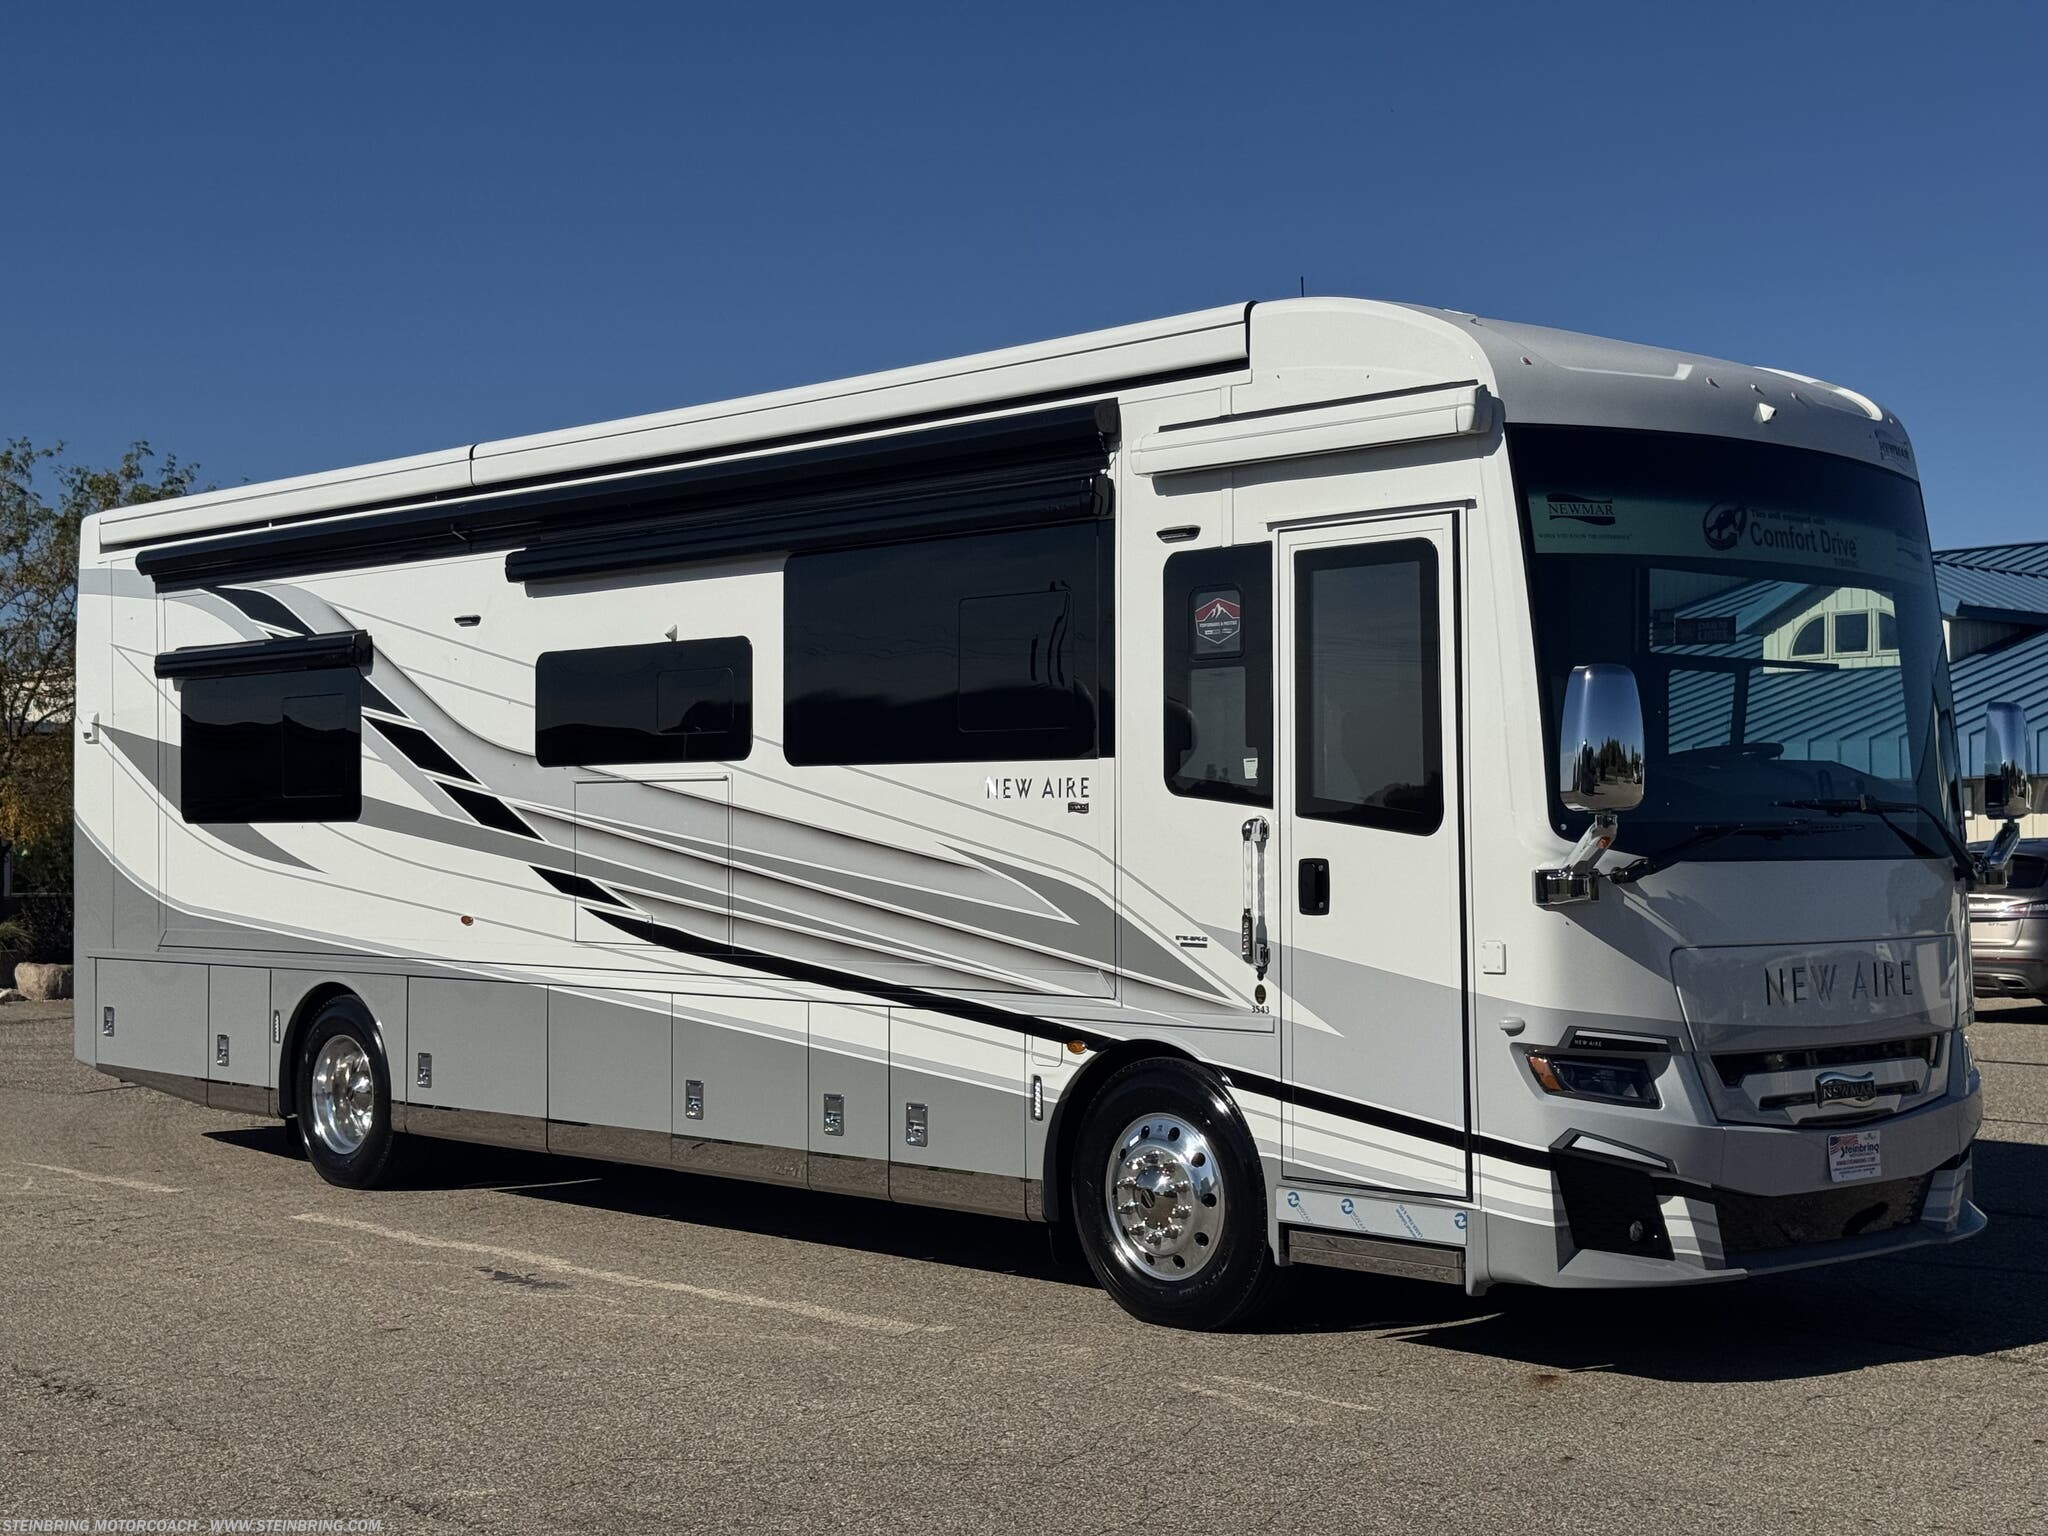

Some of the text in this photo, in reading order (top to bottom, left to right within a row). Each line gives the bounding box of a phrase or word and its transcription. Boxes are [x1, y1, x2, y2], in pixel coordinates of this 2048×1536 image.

[1547, 503, 1615, 516] NEWMAR
[1750, 521, 1857, 558] Comfort Drive
[985, 776, 1090, 799] NEW AIRE
[1764, 960, 1914, 1006] NEW AIRE
[1251, 1004, 1270, 1015] 3543
